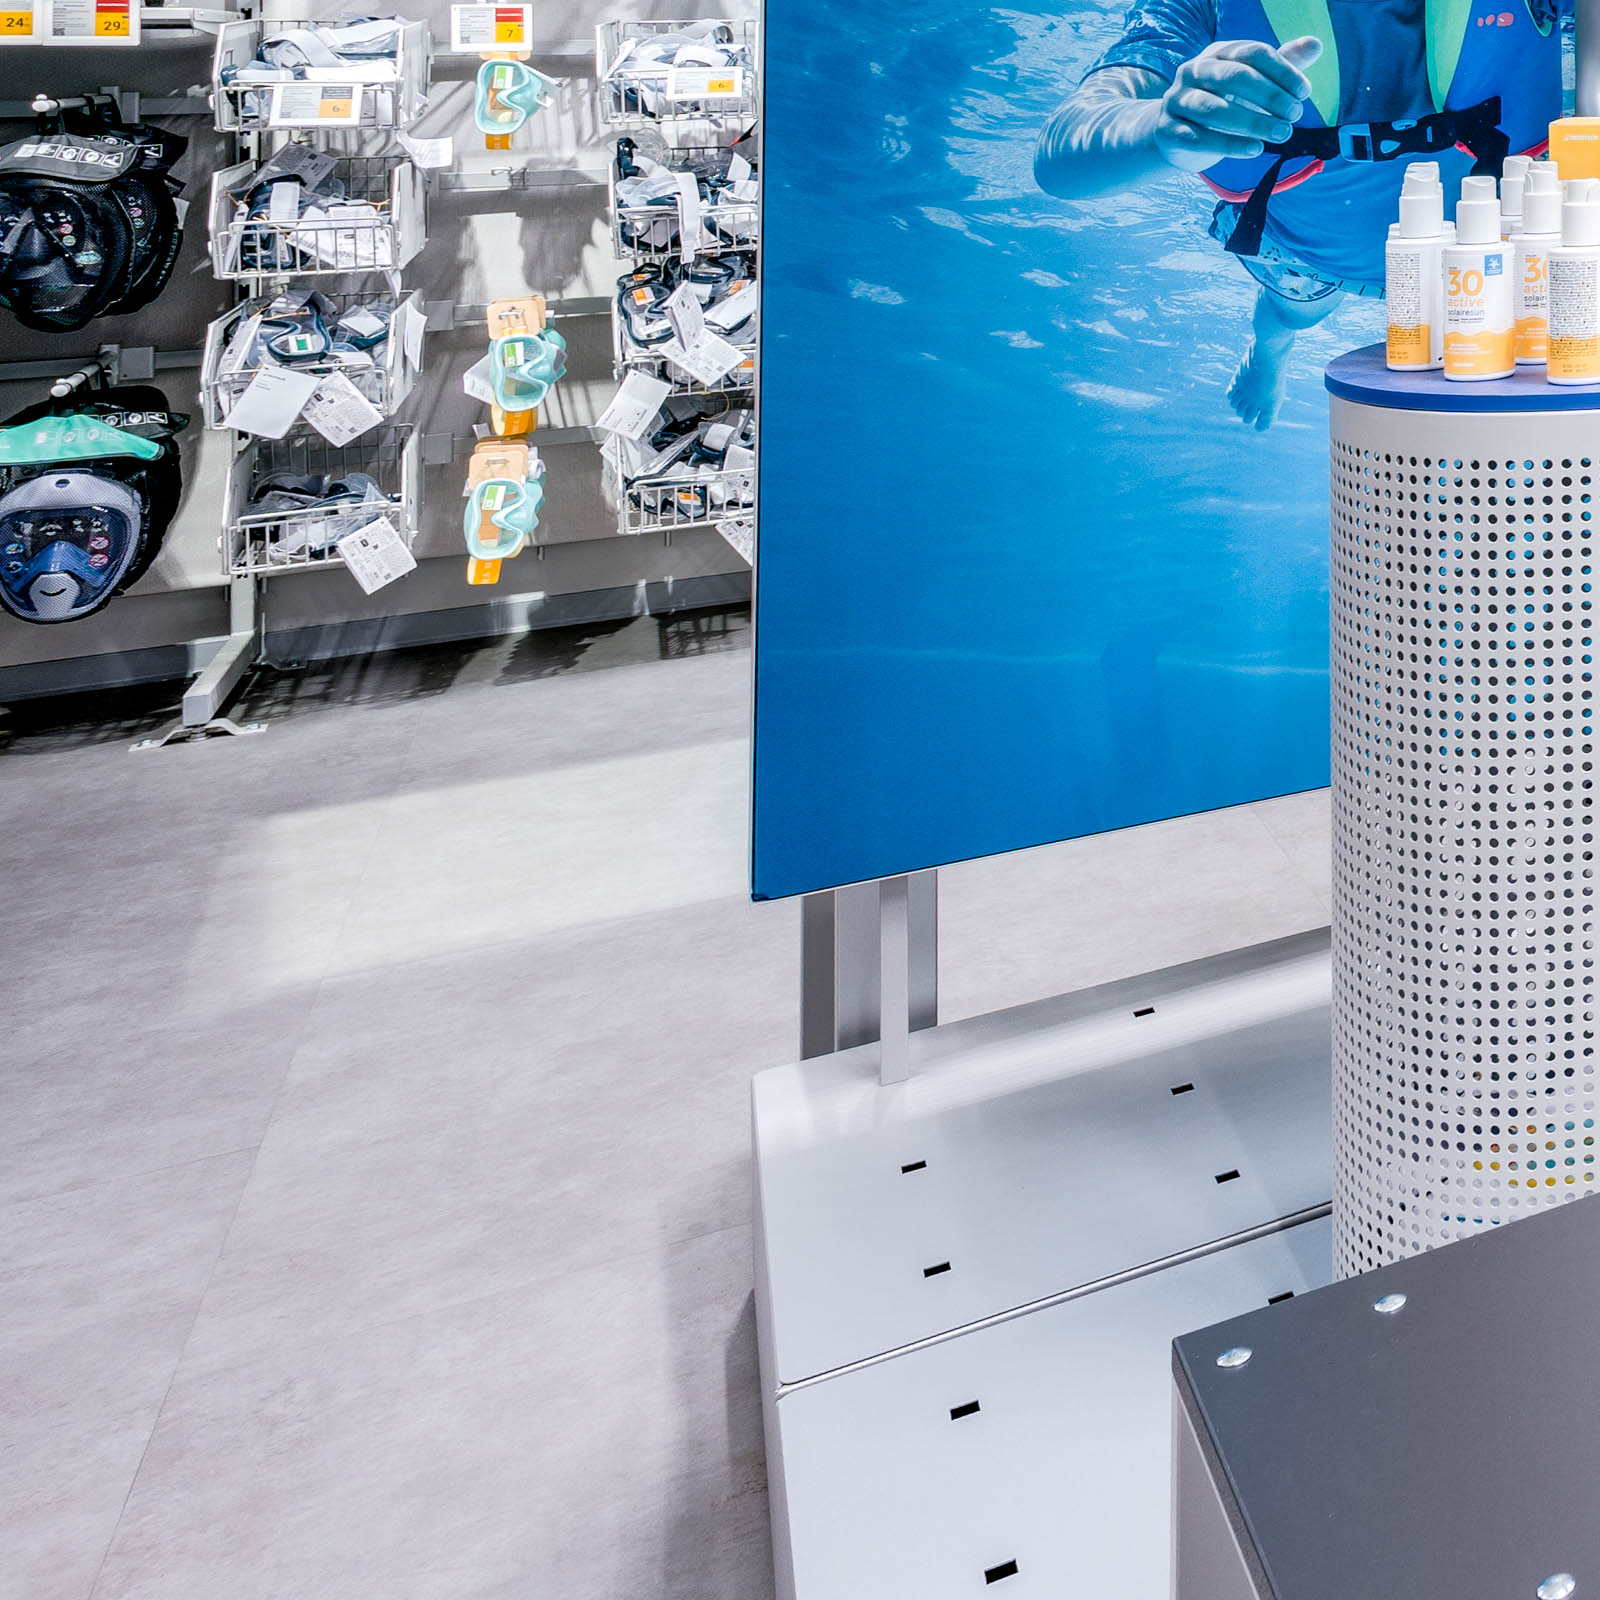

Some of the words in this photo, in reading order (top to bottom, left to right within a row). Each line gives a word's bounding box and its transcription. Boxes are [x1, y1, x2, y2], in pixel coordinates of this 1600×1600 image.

[6, 17, 25, 28] 24
[103, 21, 121, 31] 29
[1447, 269, 1484, 297] 30
[1447, 298, 1485, 308] active
